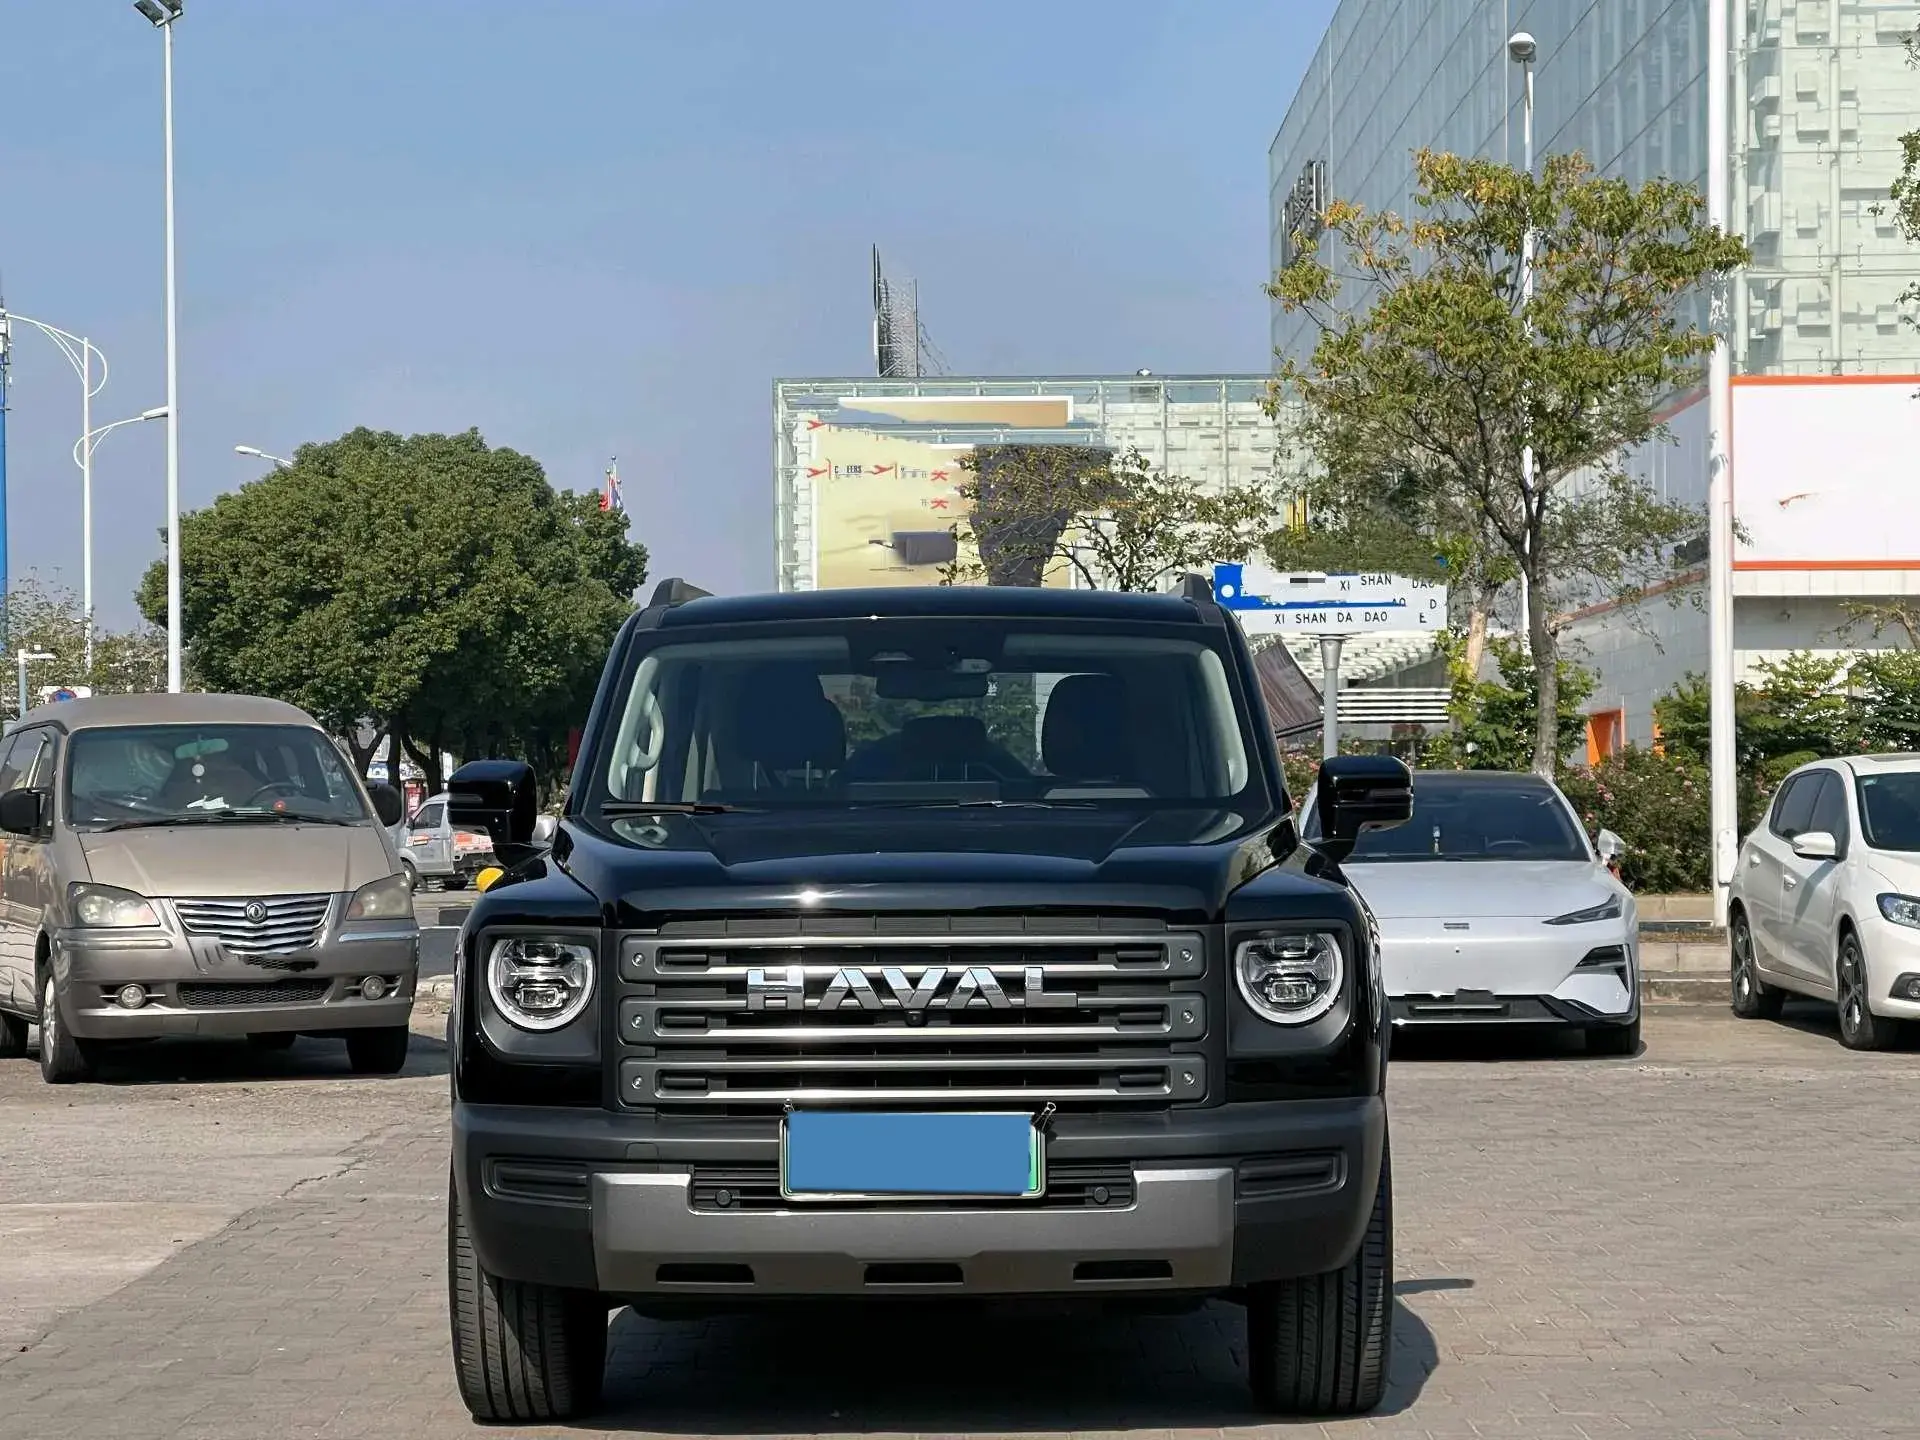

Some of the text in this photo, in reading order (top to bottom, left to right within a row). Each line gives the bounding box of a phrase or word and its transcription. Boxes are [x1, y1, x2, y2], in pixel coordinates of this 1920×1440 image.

[1340, 580, 1350, 591] XI
[1361, 575, 1392, 586] SHAN
[1274, 611, 1388, 625] XI SHAN DA DAO
[746, 967, 1078, 1010] HAVAL
